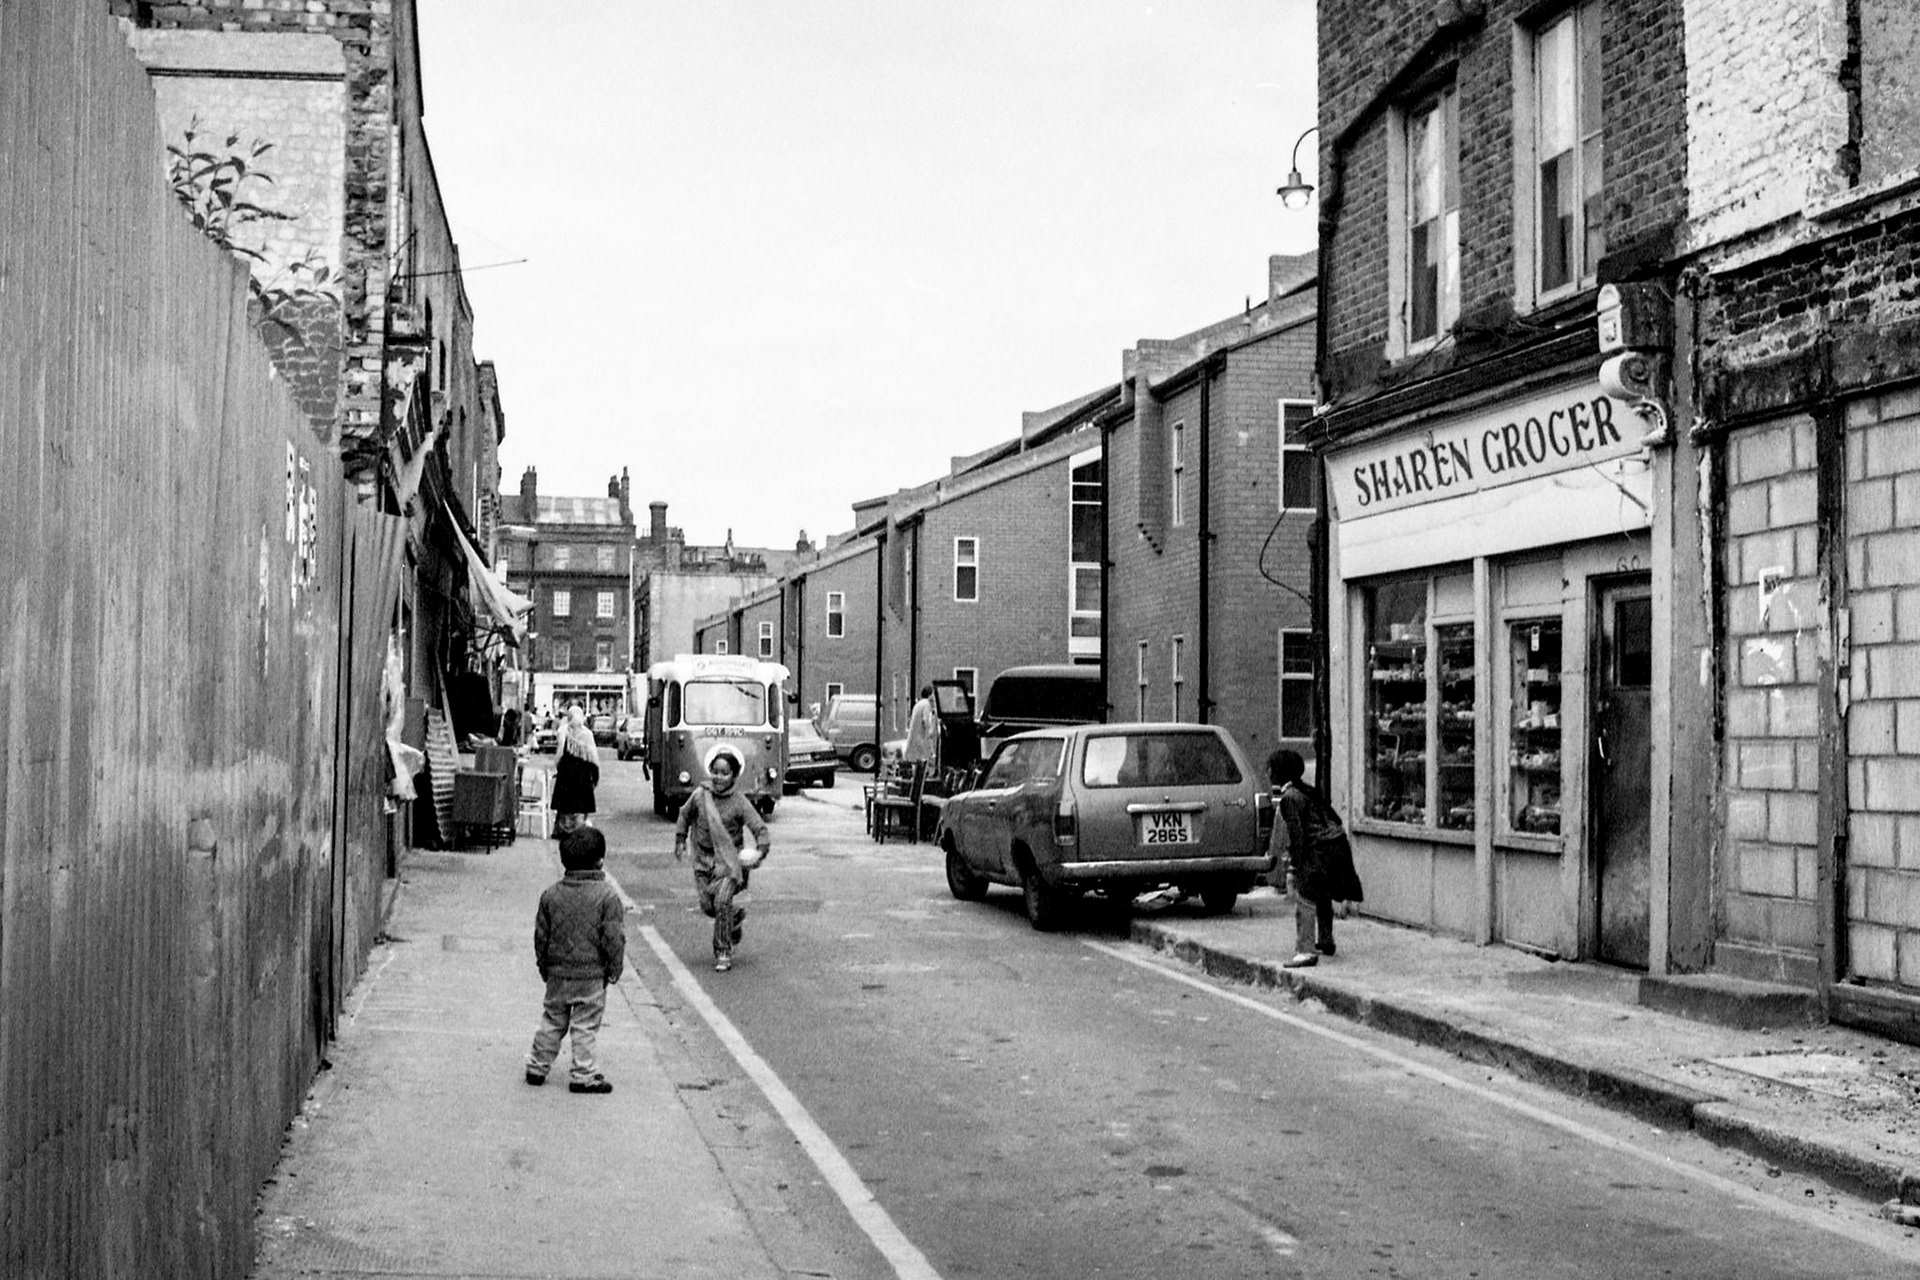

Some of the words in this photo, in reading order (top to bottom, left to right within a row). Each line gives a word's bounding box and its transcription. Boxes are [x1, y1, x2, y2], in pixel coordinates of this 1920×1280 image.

[1354, 438, 1474, 507] SHAREN
[1481, 395, 1622, 474] GROCER
[1152, 812, 1182, 827] VKN
[1148, 829, 1187, 843] 286S
